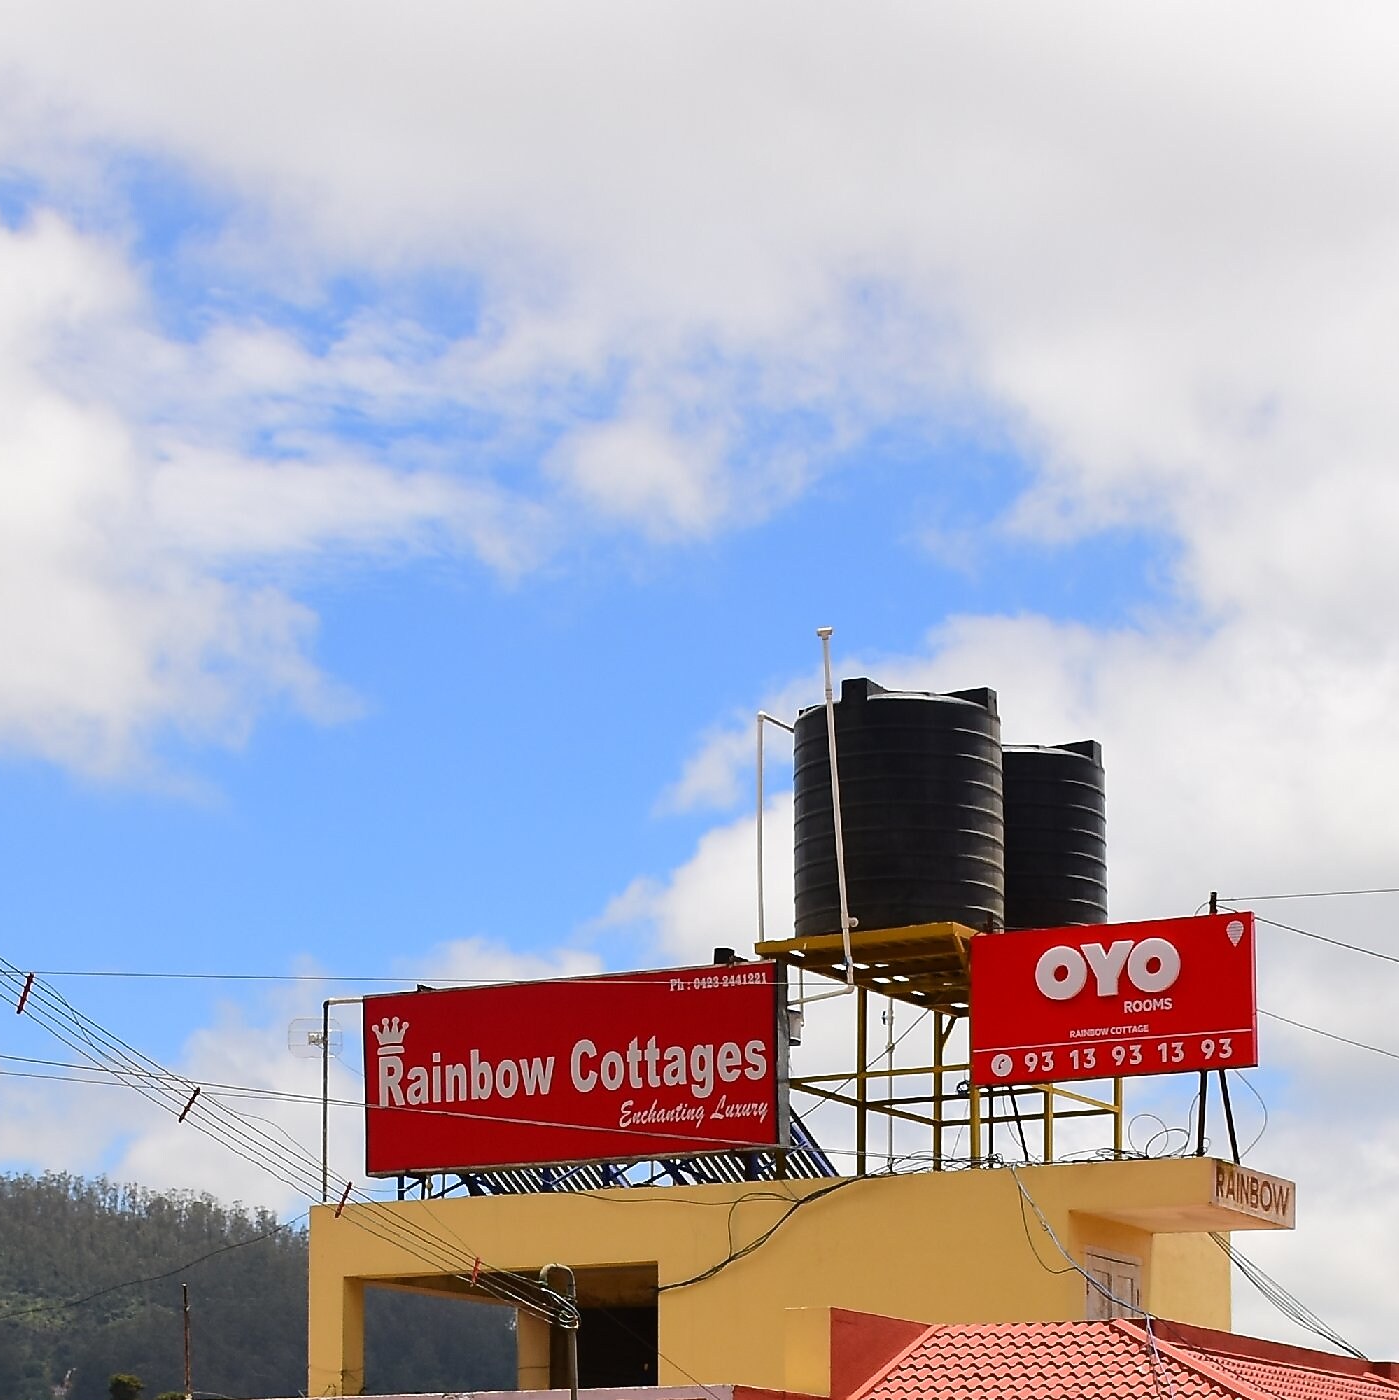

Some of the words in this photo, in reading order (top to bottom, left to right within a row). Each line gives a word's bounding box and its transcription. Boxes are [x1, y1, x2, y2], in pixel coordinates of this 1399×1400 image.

[1035, 937, 1181, 1000] OYO
[1123, 997, 1173, 1014] ROOMS
[1069, 1027, 1109, 1039] RAINBOW
[1110, 1024, 1150, 1035] COTTAGE
[378, 1048, 555, 1107] Rainbow
[570, 1036, 767, 1098] Cottages
[1024, 1051, 1054, 1073] 93
[1070, 1047, 1097, 1070] 13
[1112, 1044, 1143, 1066] 93
[1158, 1042, 1185, 1063] 13
[1201, 1038, 1233, 1060] 93
[619, 1099, 705, 1128] Enchanting
[710, 1094, 768, 1123] Luxury
[1215, 1164, 1290, 1217] RAINBOW
